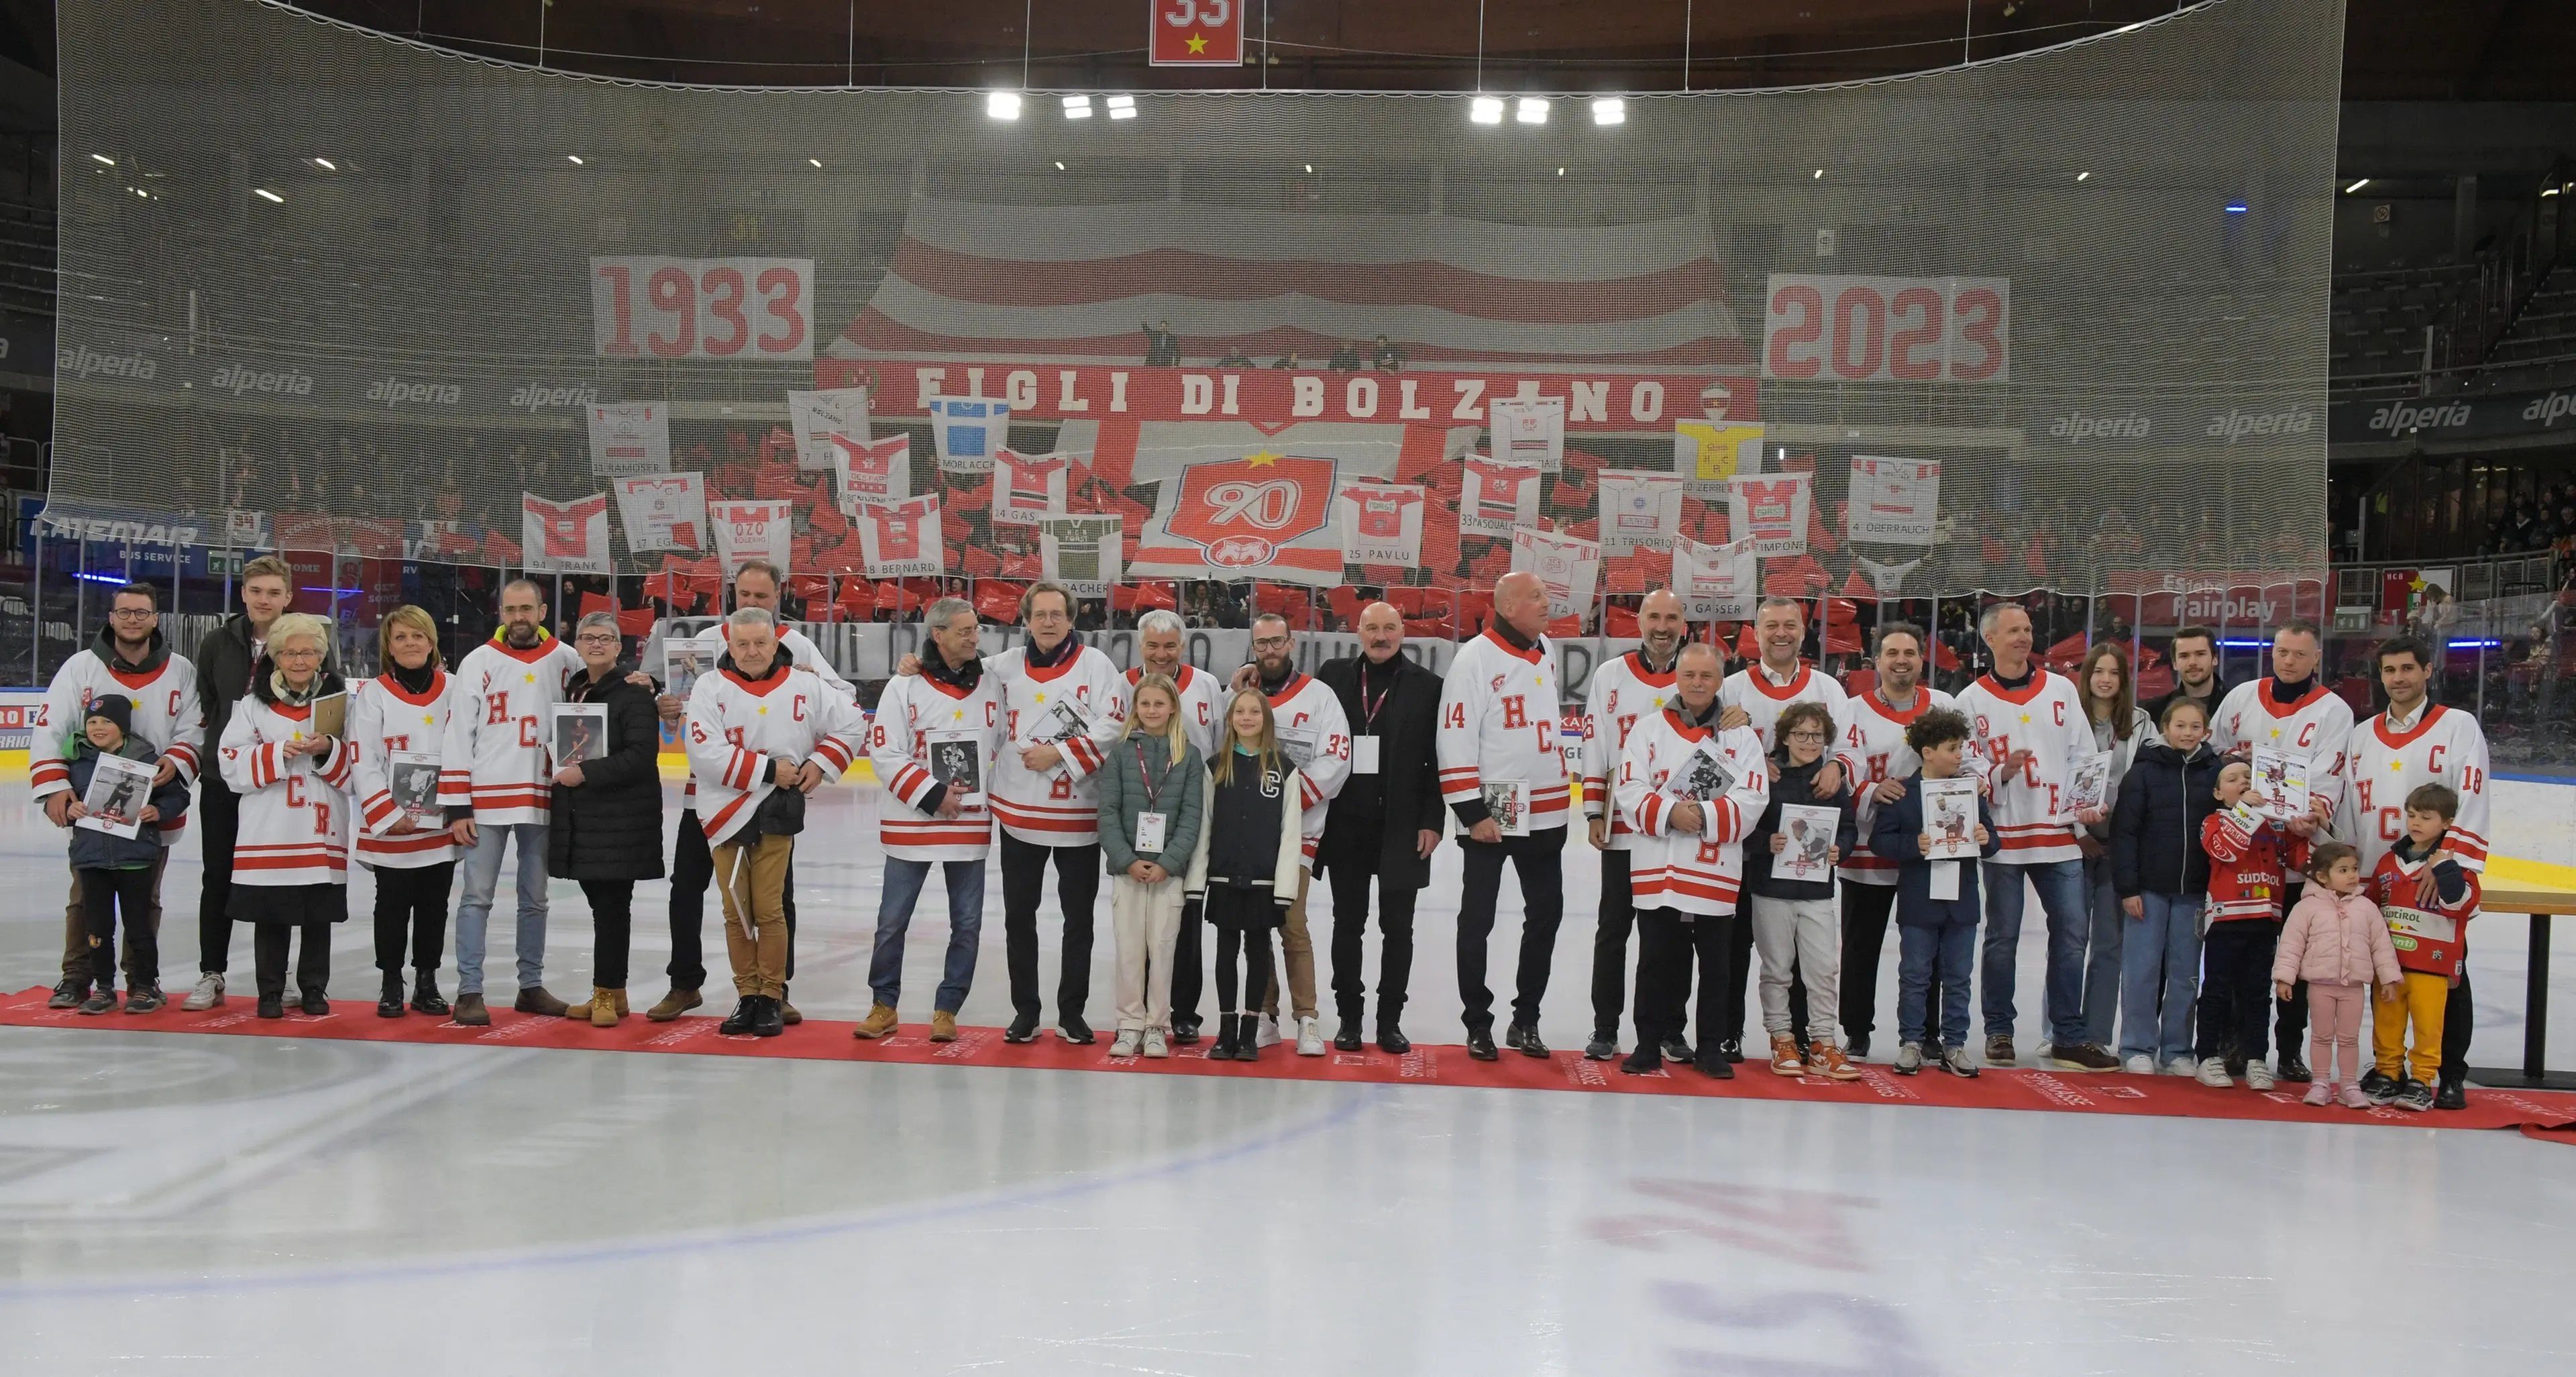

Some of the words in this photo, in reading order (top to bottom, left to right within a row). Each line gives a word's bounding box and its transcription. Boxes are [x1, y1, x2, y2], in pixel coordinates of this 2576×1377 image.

[600, 266, 806, 357] 1933
[1769, 285, 2003, 380] 2023
[58, 346, 158, 380] alperia
[210, 360, 314, 396] alperia
[366, 376, 462, 407] alperia
[916, 368, 1129, 412] FIGLI
[1182, 374, 1240, 415] DI
[510, 382, 598, 412] alperia
[2049, 410, 2151, 444] alperia
[2206, 405, 2314, 443] alperia
[2368, 400, 2471, 437] alperia
[607, 463, 659, 472] RAMOSER
[1204, 479, 1303, 530] 90
[30, 514, 199, 549] LATEMAR
[1461, 514, 1472, 526] 33
[1866, 523, 1930, 534] OBERRAUCH
[1349, 549, 1361, 559] 25
[1368, 549, 1410, 560] PAVLU
[1622, 537, 1672, 549] TRISORIO
[292, 564, 321, 573] OME
[561, 561, 597, 570] FRANK
[881, 563, 936, 574] BERNARD
[1695, 604, 1741, 614] GASSER
[2172, 596, 2277, 622] Fairplay
[168, 690, 181, 717] C
[793, 694, 806, 722] C
[985, 701, 997, 728] C
[1108, 696, 1125, 722] 19
[1197, 701, 1208, 726] C
[1444, 702, 1465, 729] 14
[2053, 700, 2065, 726] C
[691, 721, 707, 744] 5
[873, 725, 885, 748] 8
[2298, 722, 2316, 747] C
[1326, 734, 1350, 761] 33
[2428, 745, 2446, 773] C
[1867, 752, 1890, 783] H
[2462, 765, 2483, 794] 18
[1260, 771, 1281, 798] C
[1747, 771, 1763, 794] 11
[2379, 806, 2402, 841] C
